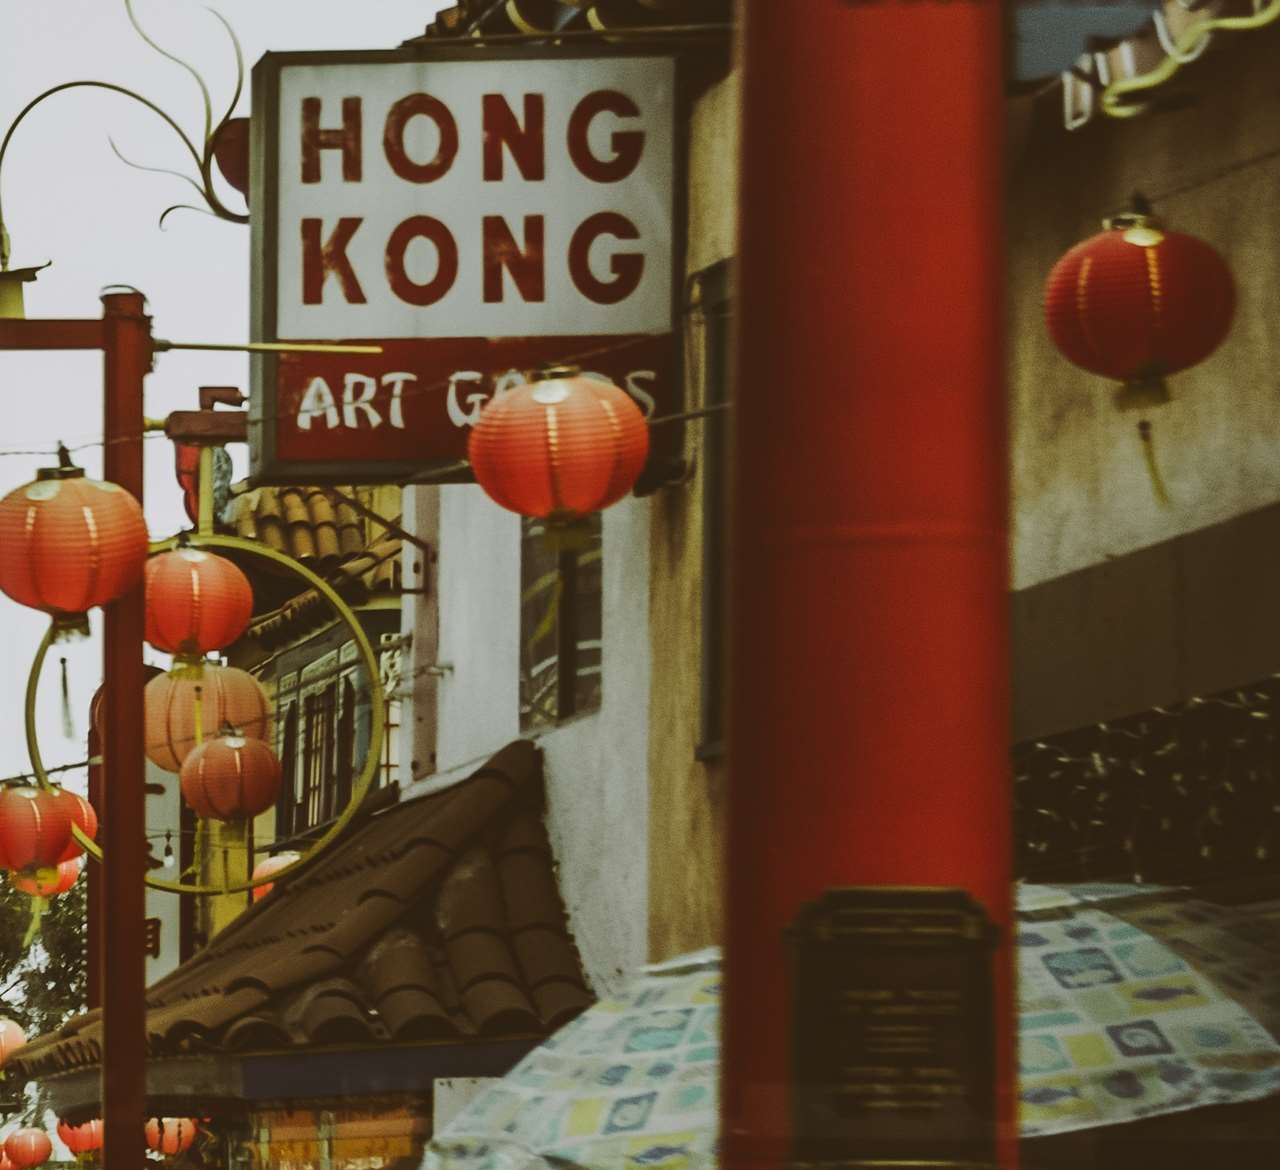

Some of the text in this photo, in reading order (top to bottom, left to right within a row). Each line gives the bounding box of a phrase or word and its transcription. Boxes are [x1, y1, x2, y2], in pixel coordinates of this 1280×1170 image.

[301, 89, 646, 183] HONG
[301, 212, 646, 306] KONG
[296, 371, 418, 430] ART
